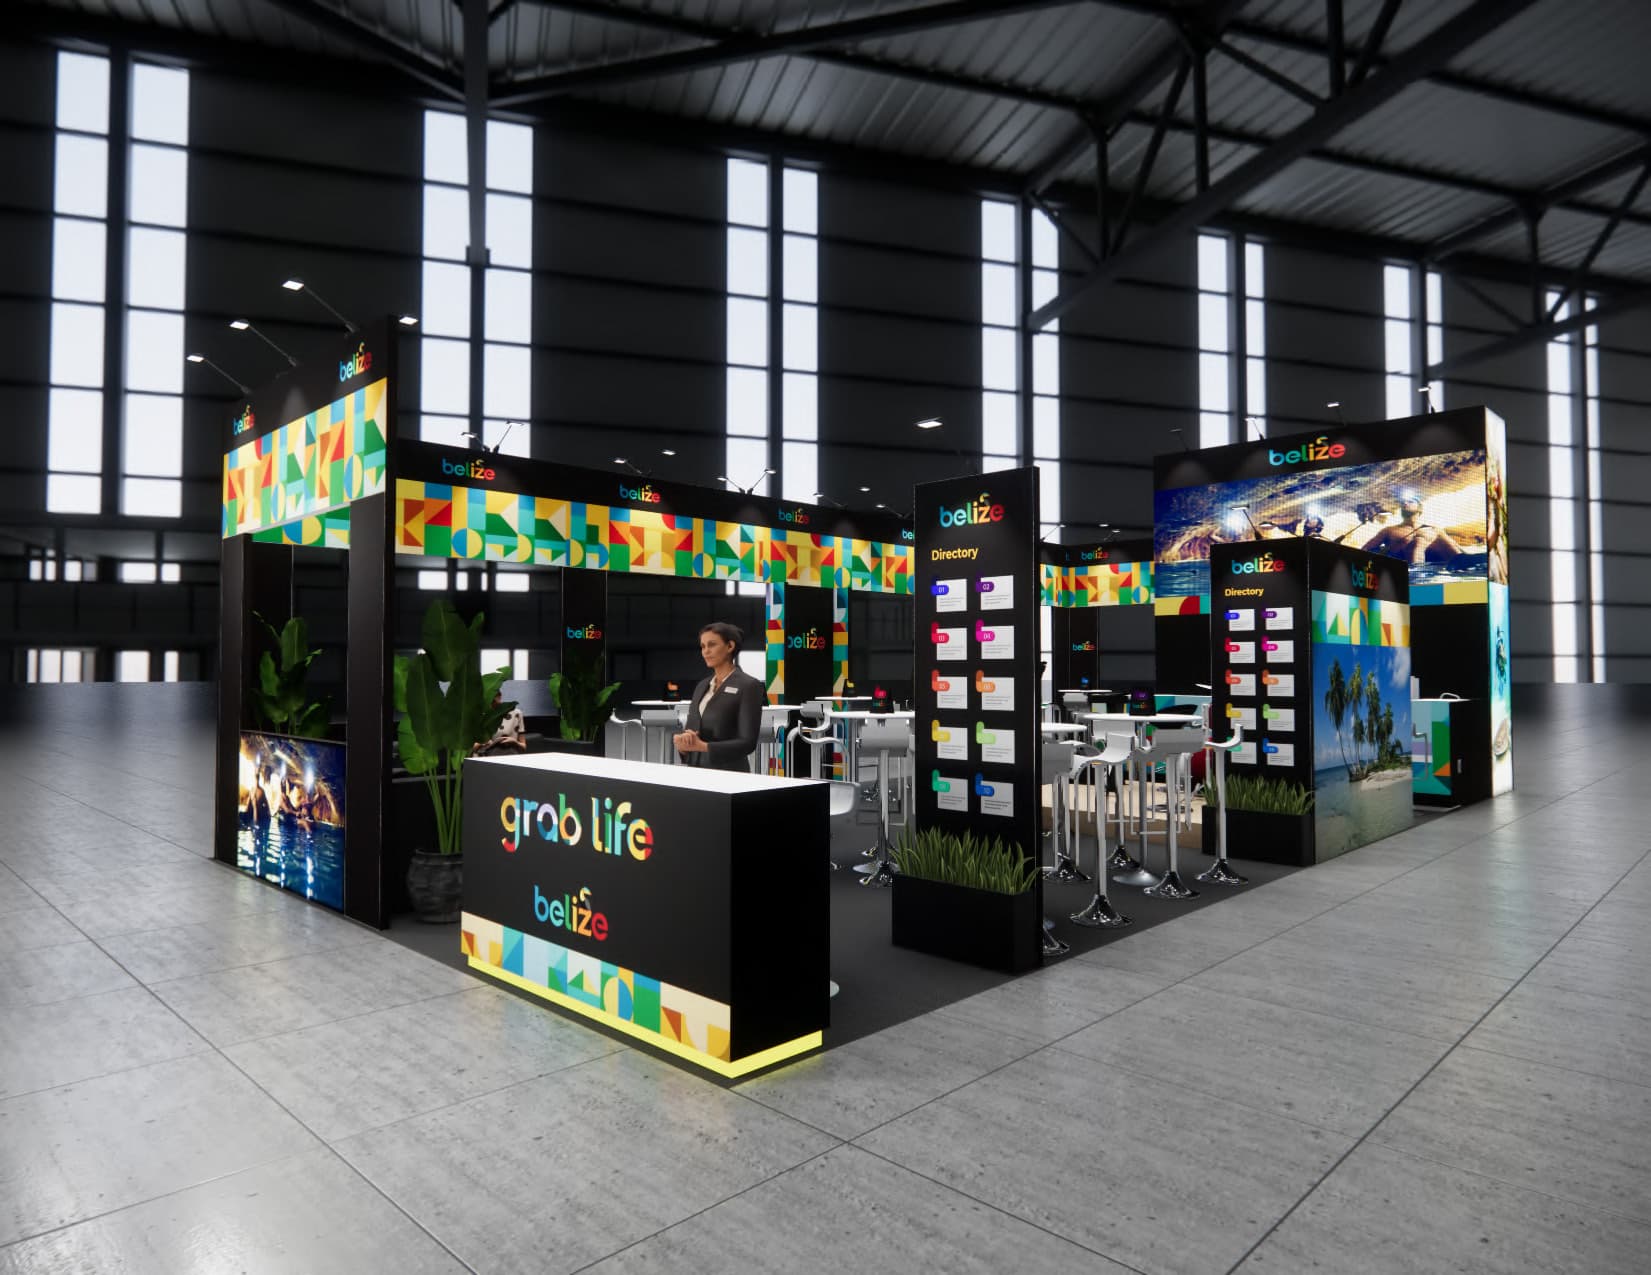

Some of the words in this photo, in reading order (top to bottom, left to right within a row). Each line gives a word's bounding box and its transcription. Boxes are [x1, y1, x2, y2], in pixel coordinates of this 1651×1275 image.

[339, 345, 373, 382] belize
[233, 408, 255, 436] belize
[1268, 438, 1346, 467] belize
[442, 458, 495, 481] belize
[619, 484, 661, 503] belize
[778, 508, 810, 524] belize
[939, 495, 1004, 528] belize
[931, 547, 979, 562] Directory
[1081, 547, 1109, 560] belize
[1231, 553, 1286, 575] belize
[1350, 560, 1379, 592] belize
[1224, 586, 1265, 599] Directory
[567, 625, 602, 641] belize
[500, 793, 583, 853] grab
[592, 796, 655, 861] life
[533, 885, 609, 941] belize
